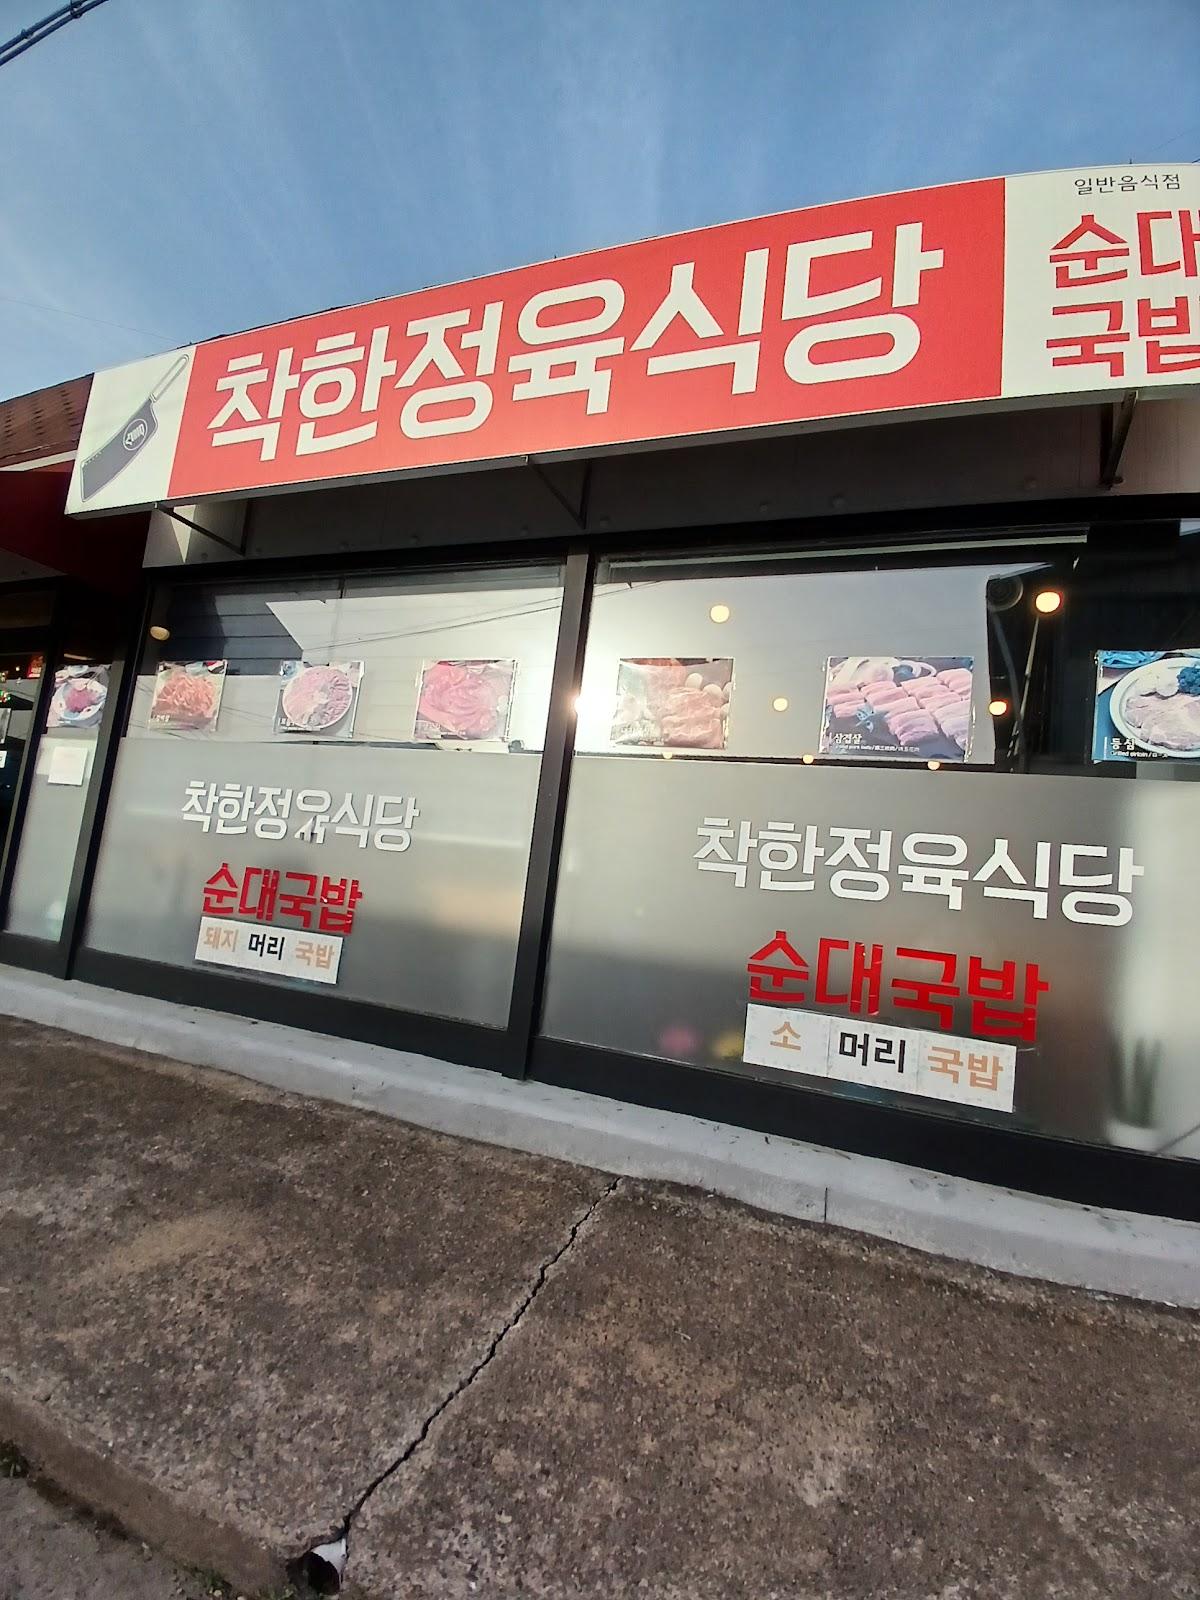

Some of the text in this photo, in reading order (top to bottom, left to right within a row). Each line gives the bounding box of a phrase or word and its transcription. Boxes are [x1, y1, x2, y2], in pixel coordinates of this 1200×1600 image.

[1074, 174, 1181, 196] 일반음식점
[1049, 209, 1200, 289] 순대
[208, 222, 944, 462] 착한정육식당
[201, 862, 363, 934] 순대국밥
[693, 817, 1145, 928] 착한정육식당
[203, 927, 335, 970] 돼지 머리 국밥
[747, 930, 1050, 1042] 순대국밥
[769, 1021, 1004, 1092] 소 머리 국밥
